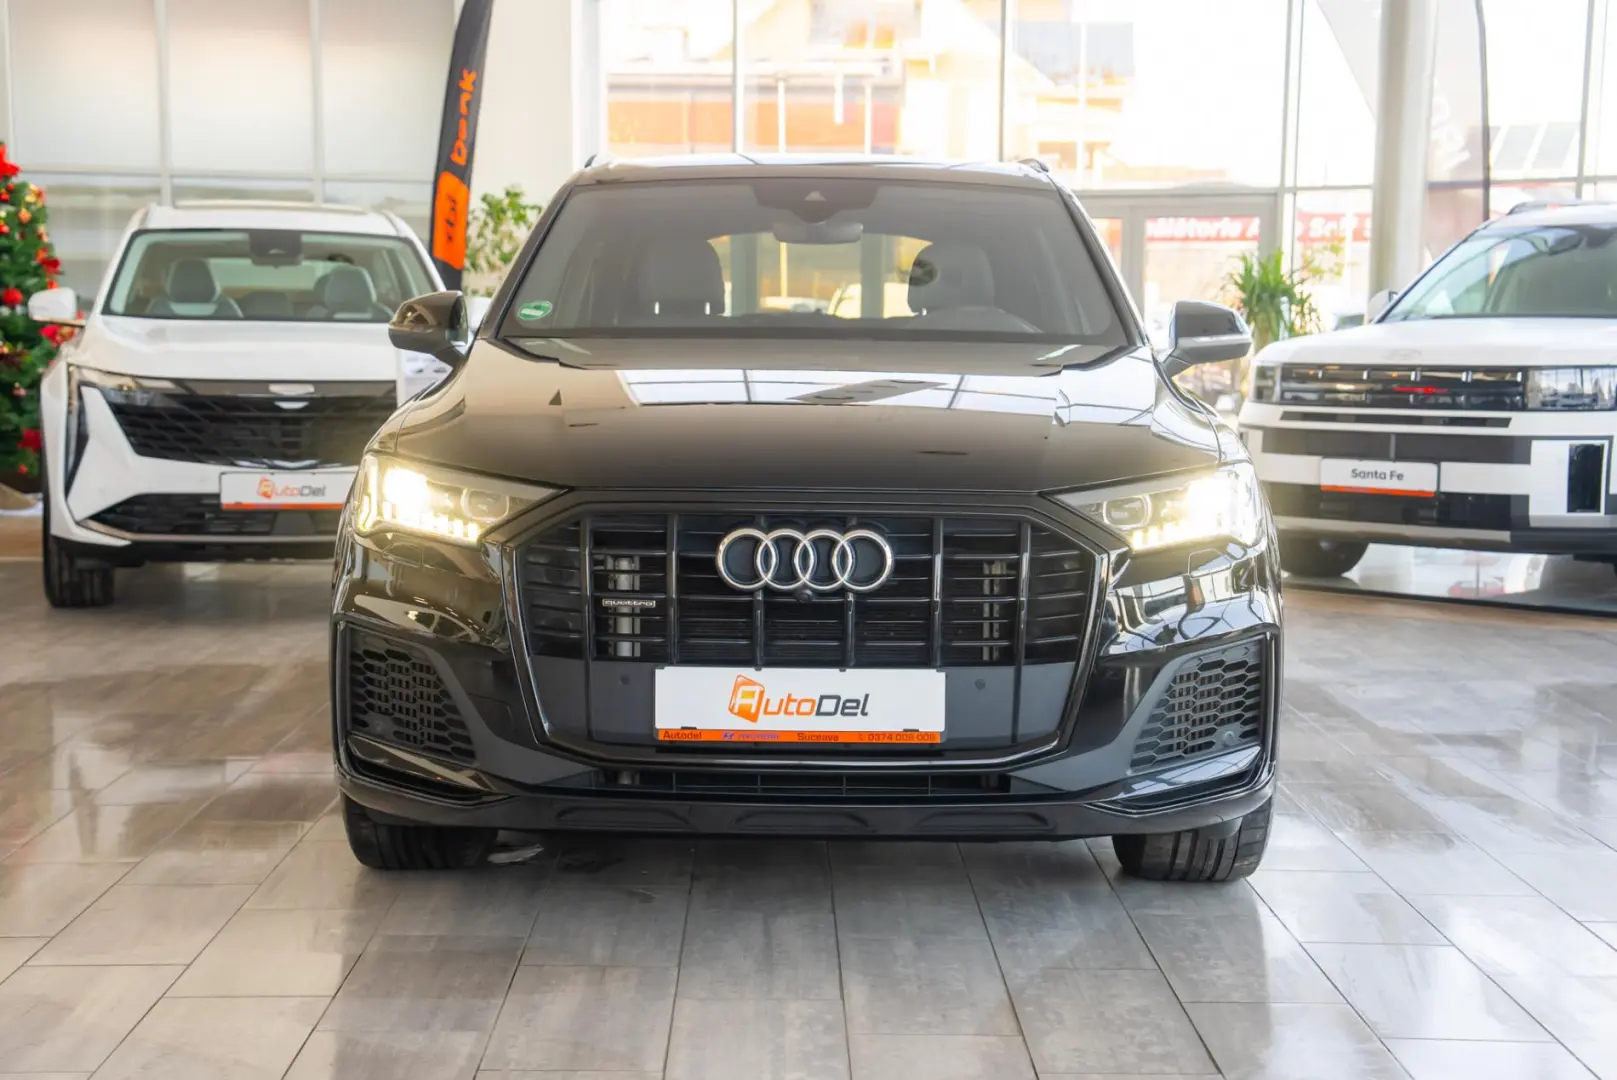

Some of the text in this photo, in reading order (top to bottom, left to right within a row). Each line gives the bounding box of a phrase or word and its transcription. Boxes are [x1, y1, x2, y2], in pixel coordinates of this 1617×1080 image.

[1351, 468, 1404, 481] Santa Fe
[257, 477, 326, 498] AutoDel
[730, 680, 870, 719] AutoDel
[663, 730, 702, 740] Autodel
[797, 732, 840, 742] Suceava
